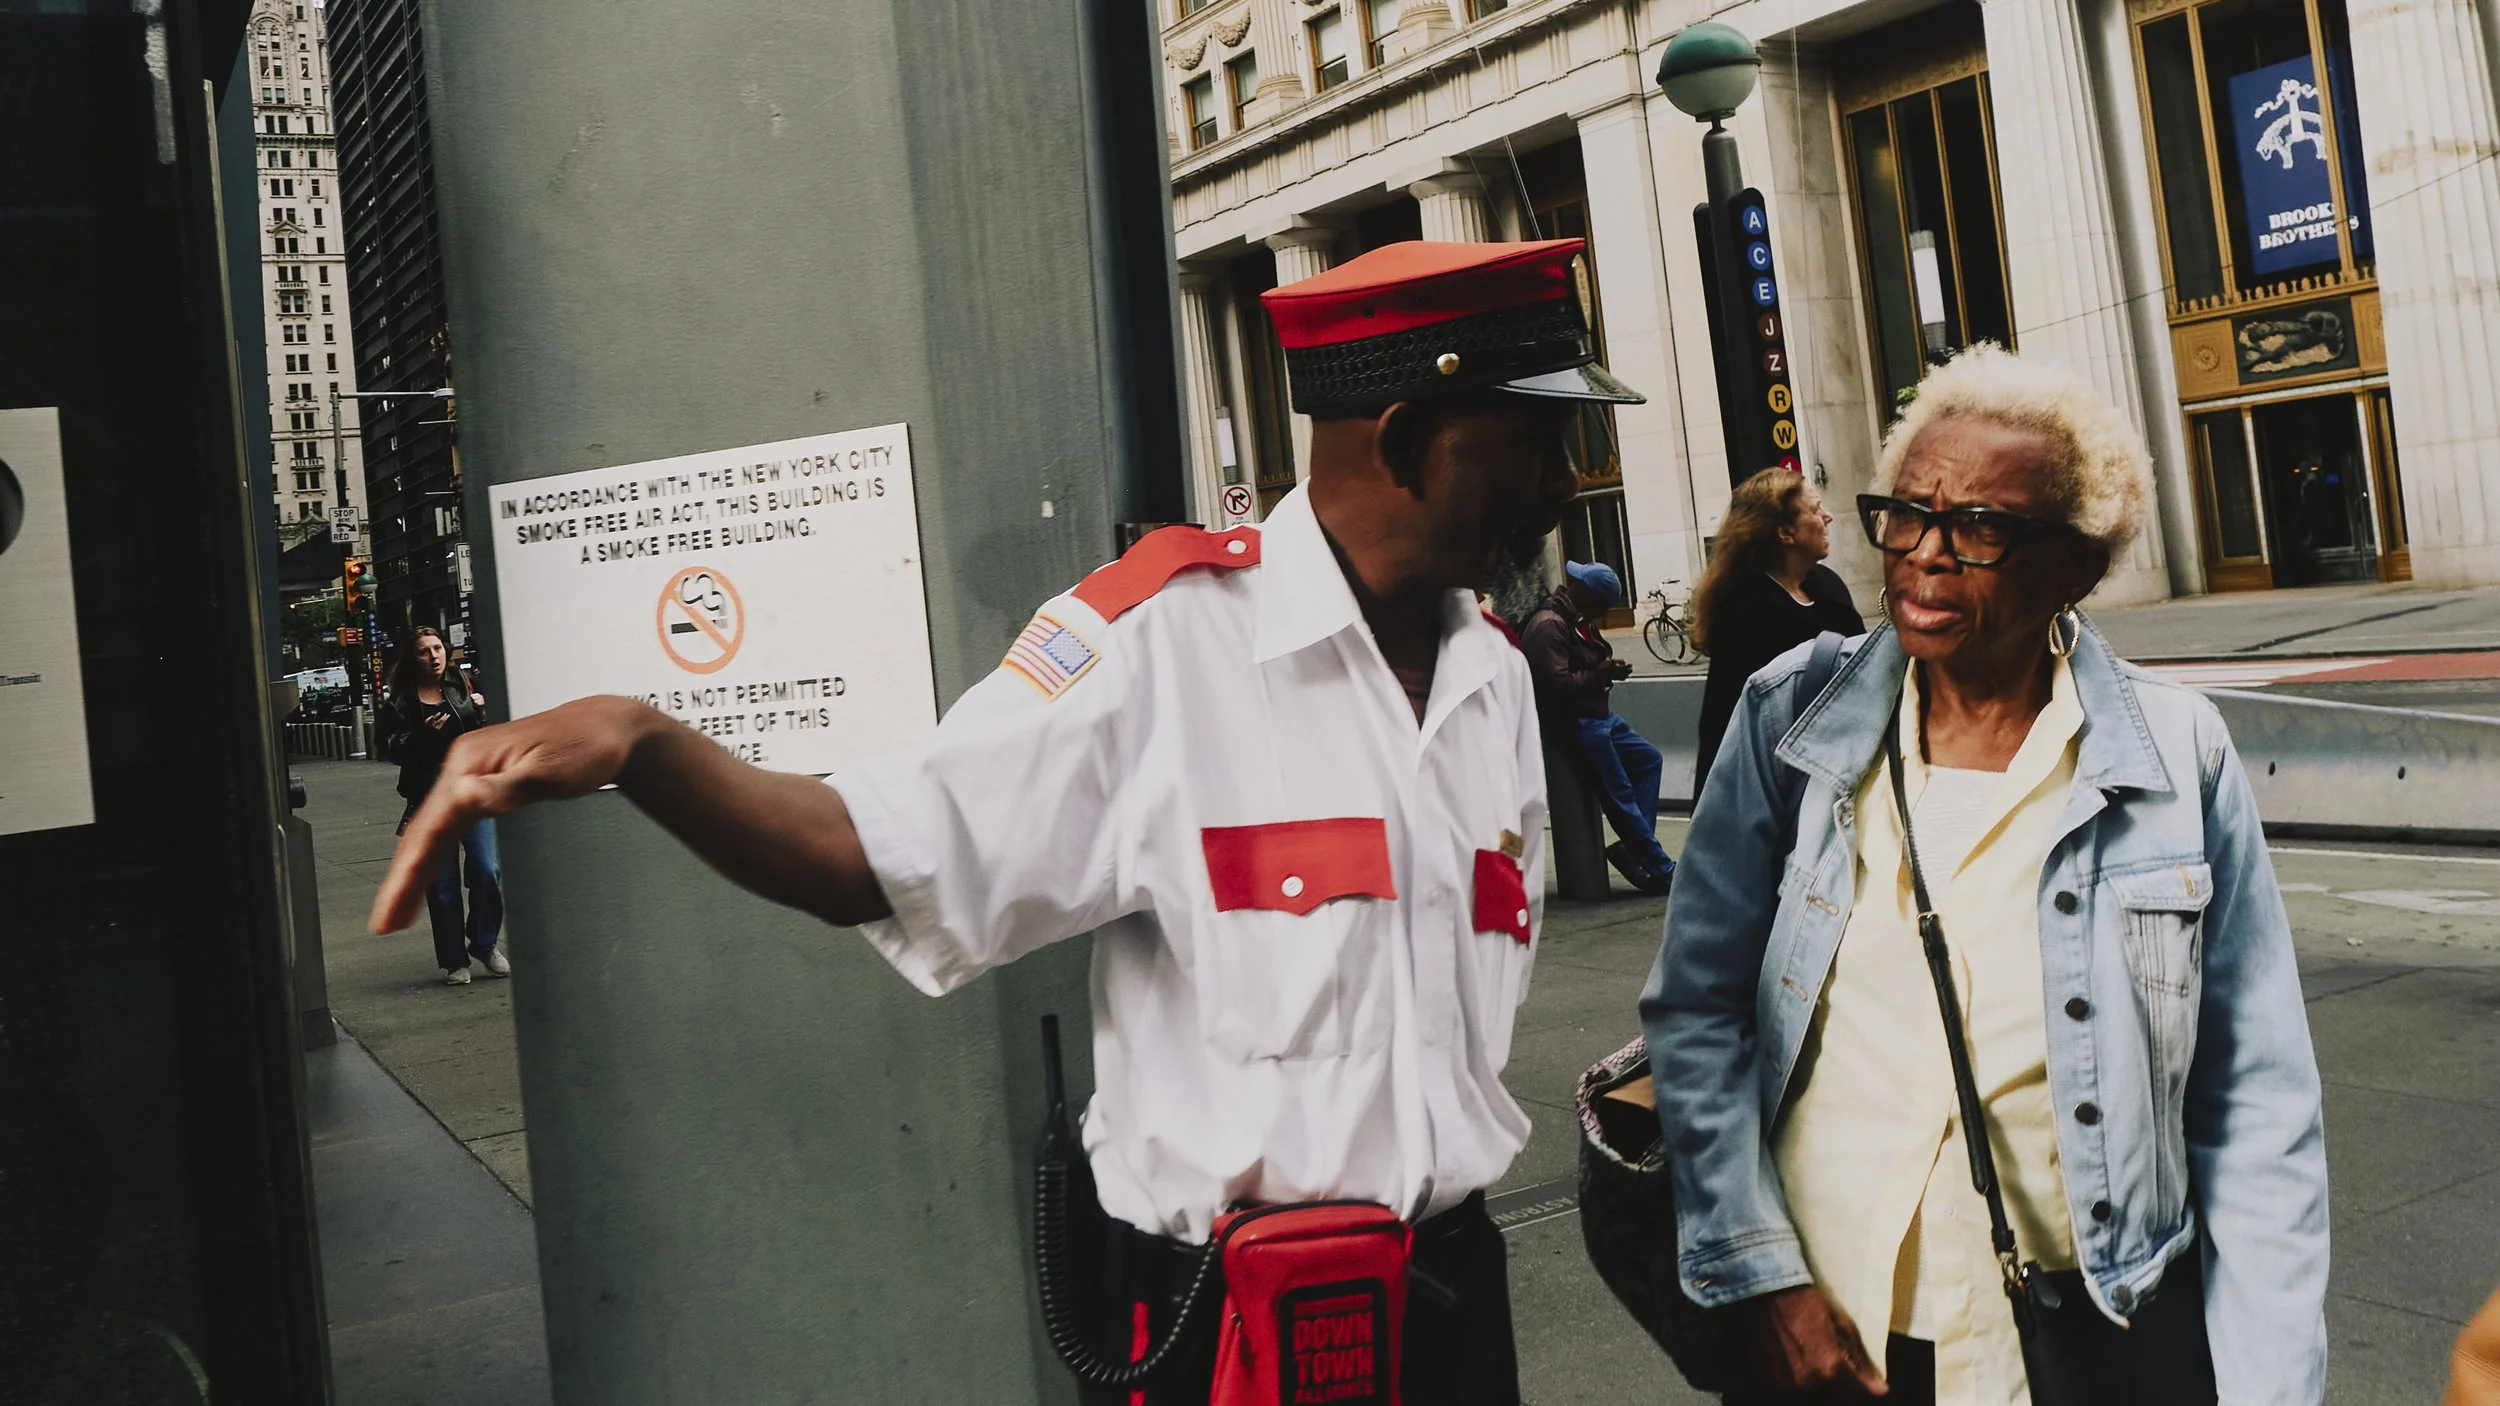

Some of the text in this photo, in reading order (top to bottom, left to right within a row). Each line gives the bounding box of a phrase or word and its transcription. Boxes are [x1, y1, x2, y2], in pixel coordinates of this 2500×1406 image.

[1749, 212, 1761, 228] A
[2268, 202, 2335, 229] BROOK
[2259, 215, 2359, 249] BROTHES
[1753, 247, 1766, 265] C
[1759, 283, 1771, 300] E
[1765, 318, 1775, 337] J
[1769, 353, 1782, 372] Z
[1774, 390, 1787, 408] R
[1776, 427, 1792, 445] W
[501, 445, 893, 519] IN ACCORDANCE WITH THE NEW YORK CITY
[333, 509, 354, 518] STOP
[517, 518, 578, 545] SMOKE
[583, 511, 628, 536] FREE
[635, 507, 664, 529] AIR
[716, 493, 760, 518] THIS
[767, 480, 858, 512] BUILDING
[867, 477, 885, 499] IS
[580, 517, 817, 564] A SMOKE FREE BUILDING.
[666, 691, 684, 711] IS
[690, 687, 727, 708] NOT
[735, 676, 846, 704] PERMITTED
[700, 707, 830, 736] FEET OF THIS
[1293, 1311, 1373, 1352] DOWN
[1295, 1345, 1374, 1386] TOWN
